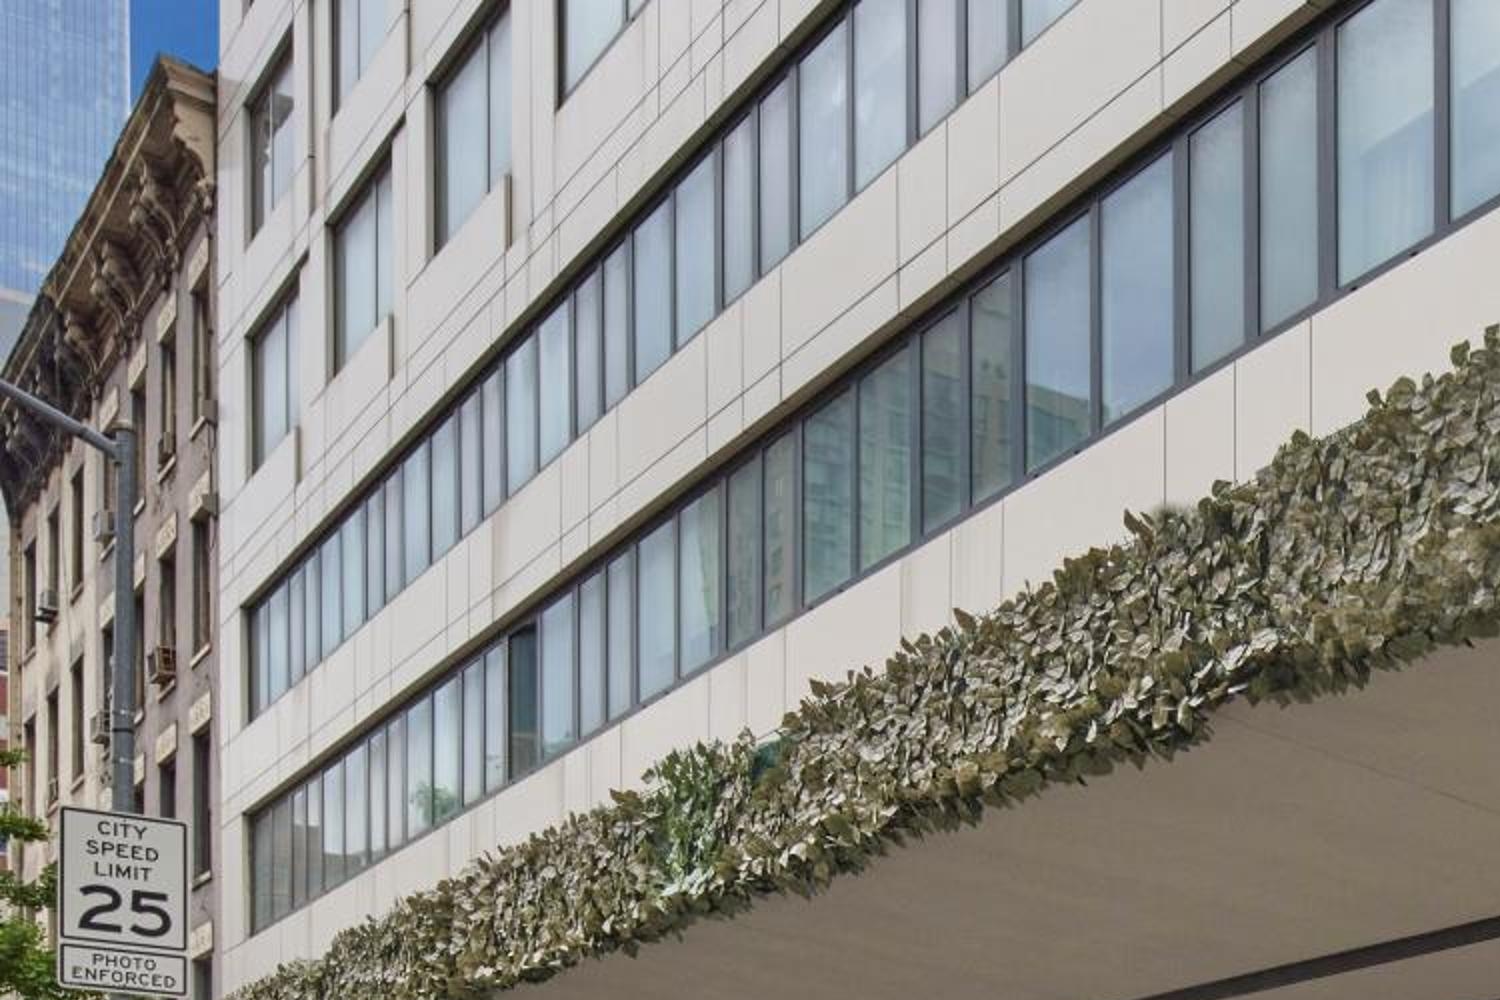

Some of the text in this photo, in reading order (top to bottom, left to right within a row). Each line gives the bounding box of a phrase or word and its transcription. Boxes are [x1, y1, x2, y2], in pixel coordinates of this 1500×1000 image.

[97, 820, 147, 840] CITY
[86, 839, 159, 862] SPEED
[94, 861, 154, 882] LIMIT
[78, 884, 172, 938] 25
[92, 953, 157, 971] PHOTO
[72, 966, 176, 989] ENFORCED
